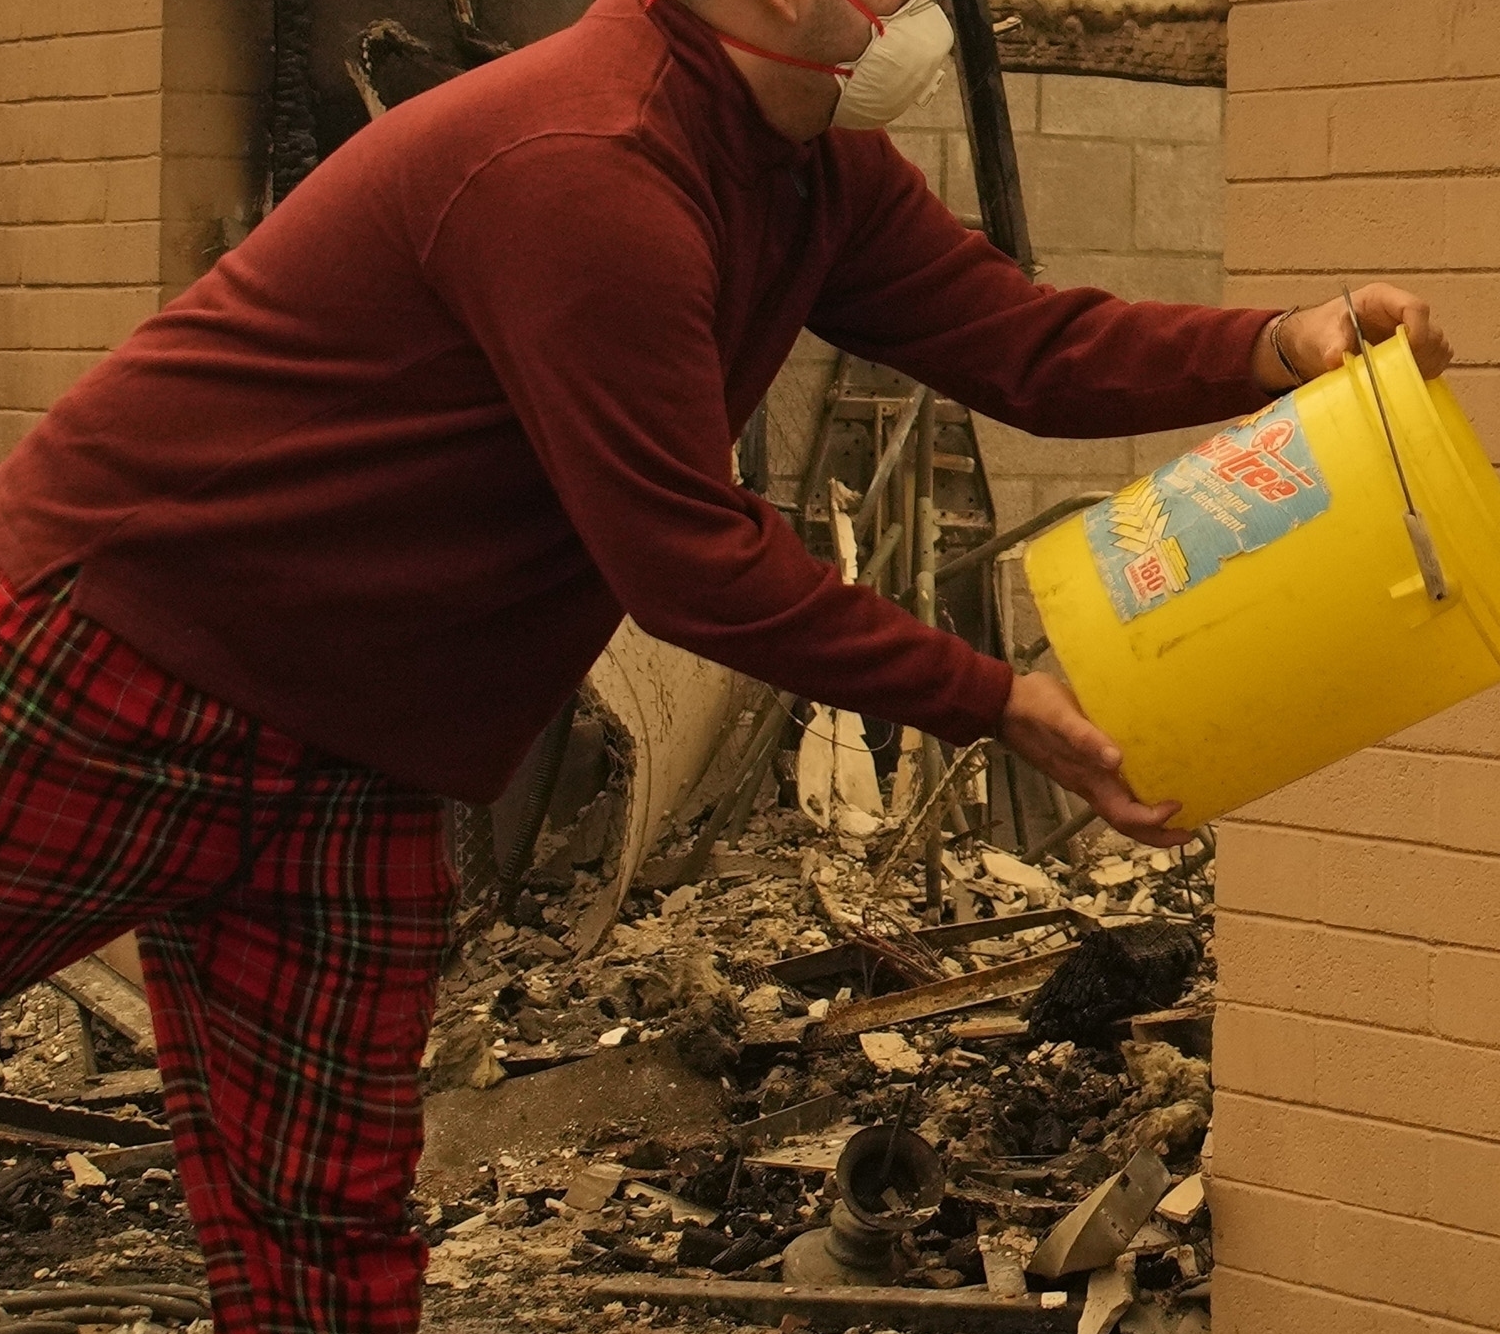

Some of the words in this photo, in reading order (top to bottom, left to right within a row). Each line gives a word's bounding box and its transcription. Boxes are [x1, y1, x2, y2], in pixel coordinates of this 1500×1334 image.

[1186, 464, 1252, 514] oncentrated
[1191, 490, 1248, 533] detergent
[1138, 555, 1167, 592] 160
